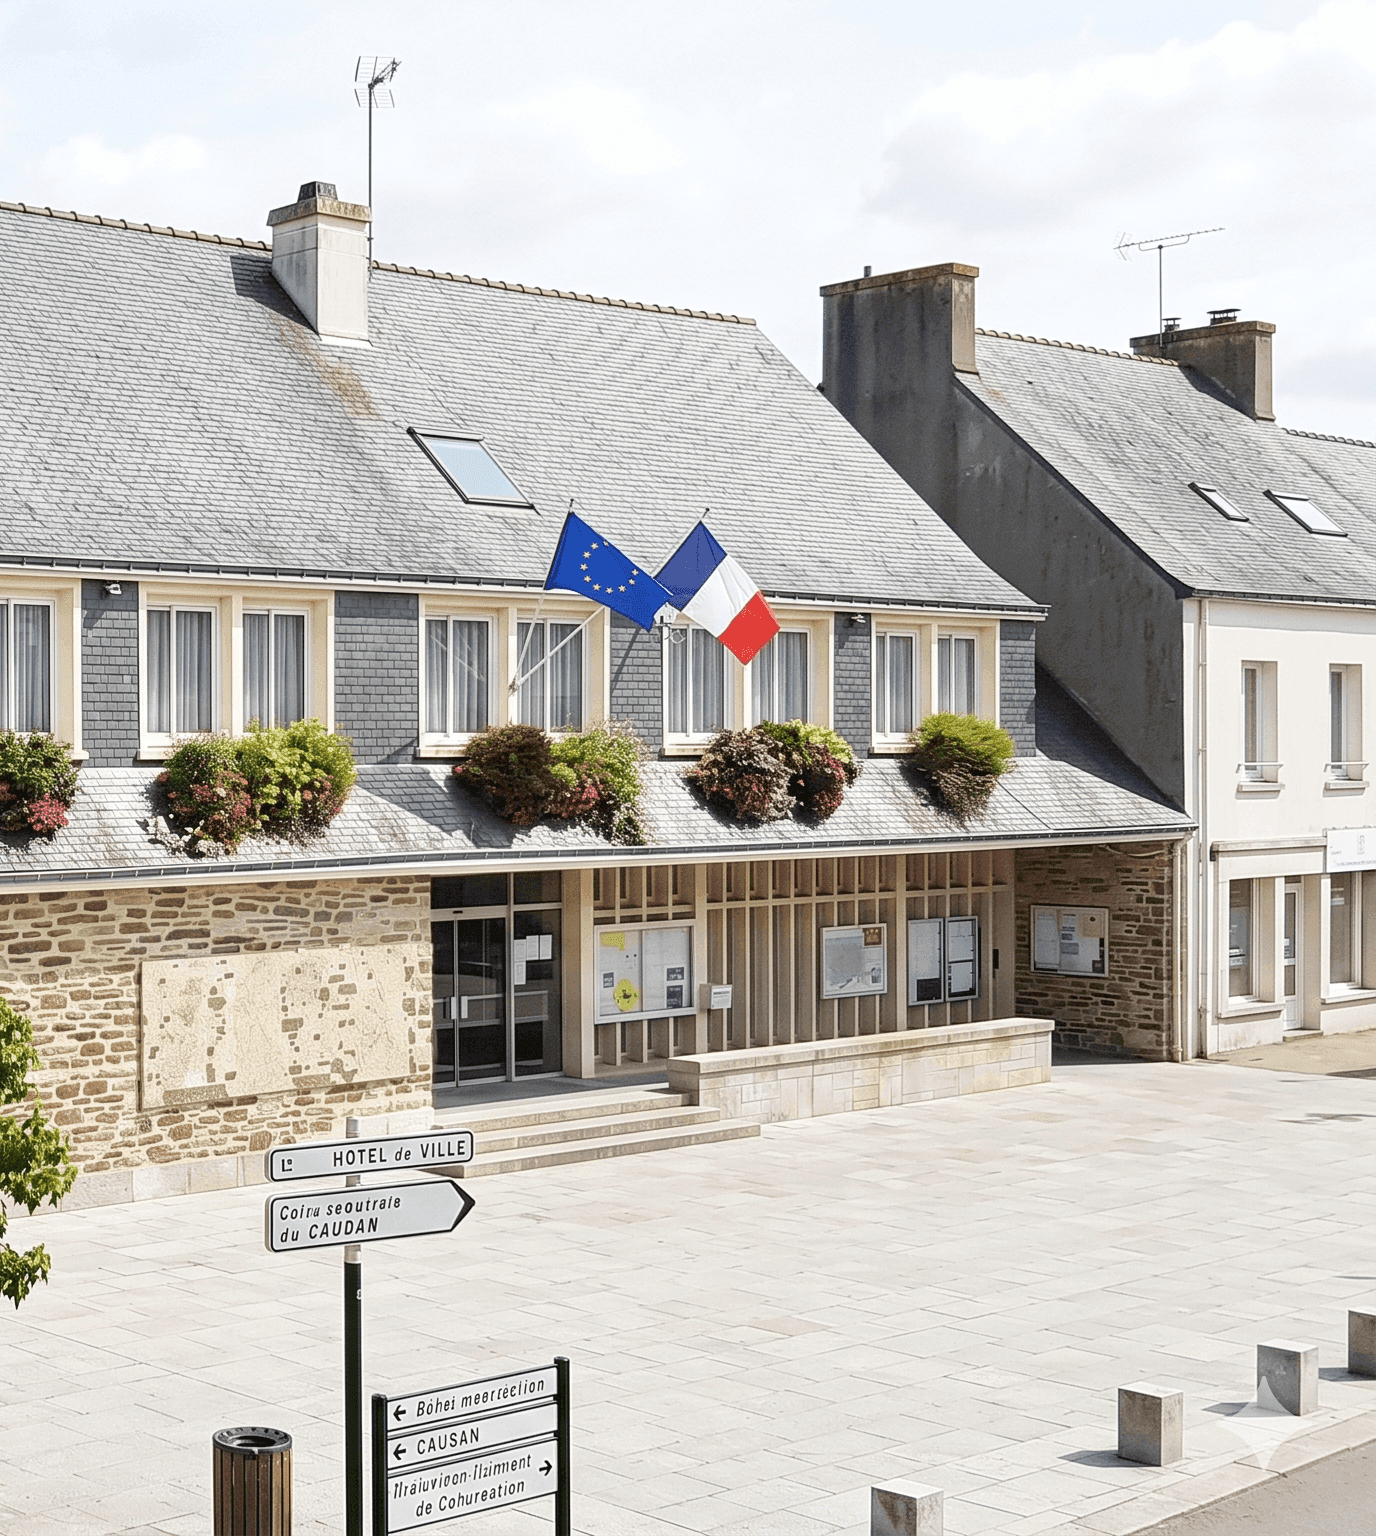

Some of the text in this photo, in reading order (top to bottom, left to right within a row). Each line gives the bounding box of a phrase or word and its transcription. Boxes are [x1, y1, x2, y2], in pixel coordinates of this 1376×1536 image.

[333, 1147, 387, 1167] HOTEL
[394, 1146, 412, 1162] de
[420, 1139, 466, 1159] VILLE
[280, 1216, 379, 1243] du CAUDAN
[417, 1427, 480, 1455] CAUSAN
[415, 1479, 525, 1518] de Cohureation
